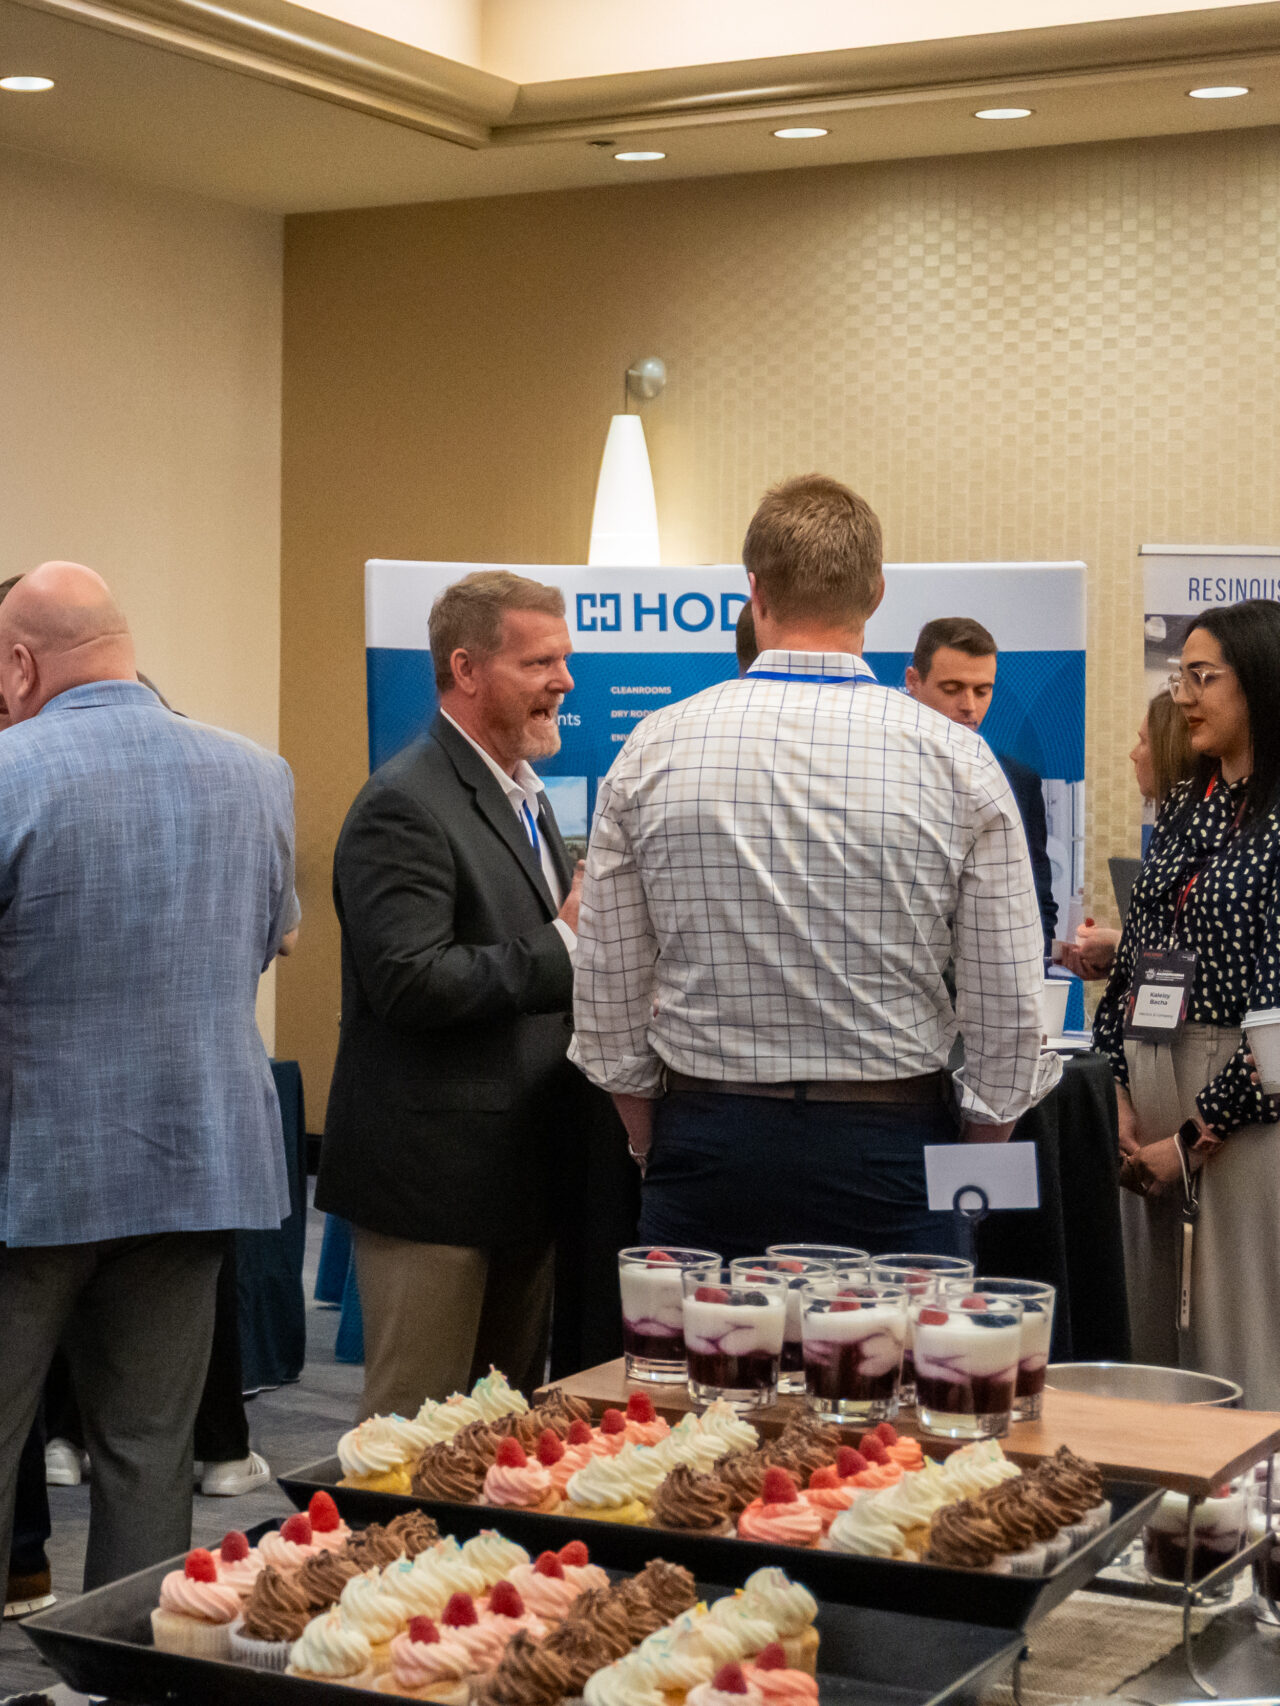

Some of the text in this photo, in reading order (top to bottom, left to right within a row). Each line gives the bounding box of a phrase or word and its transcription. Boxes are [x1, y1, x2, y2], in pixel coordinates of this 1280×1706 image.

[1188, 577, 1280, 602] RESINOU
[610, 686, 672, 695] CLEANROOMS
[630, 709, 656, 718] ROO
